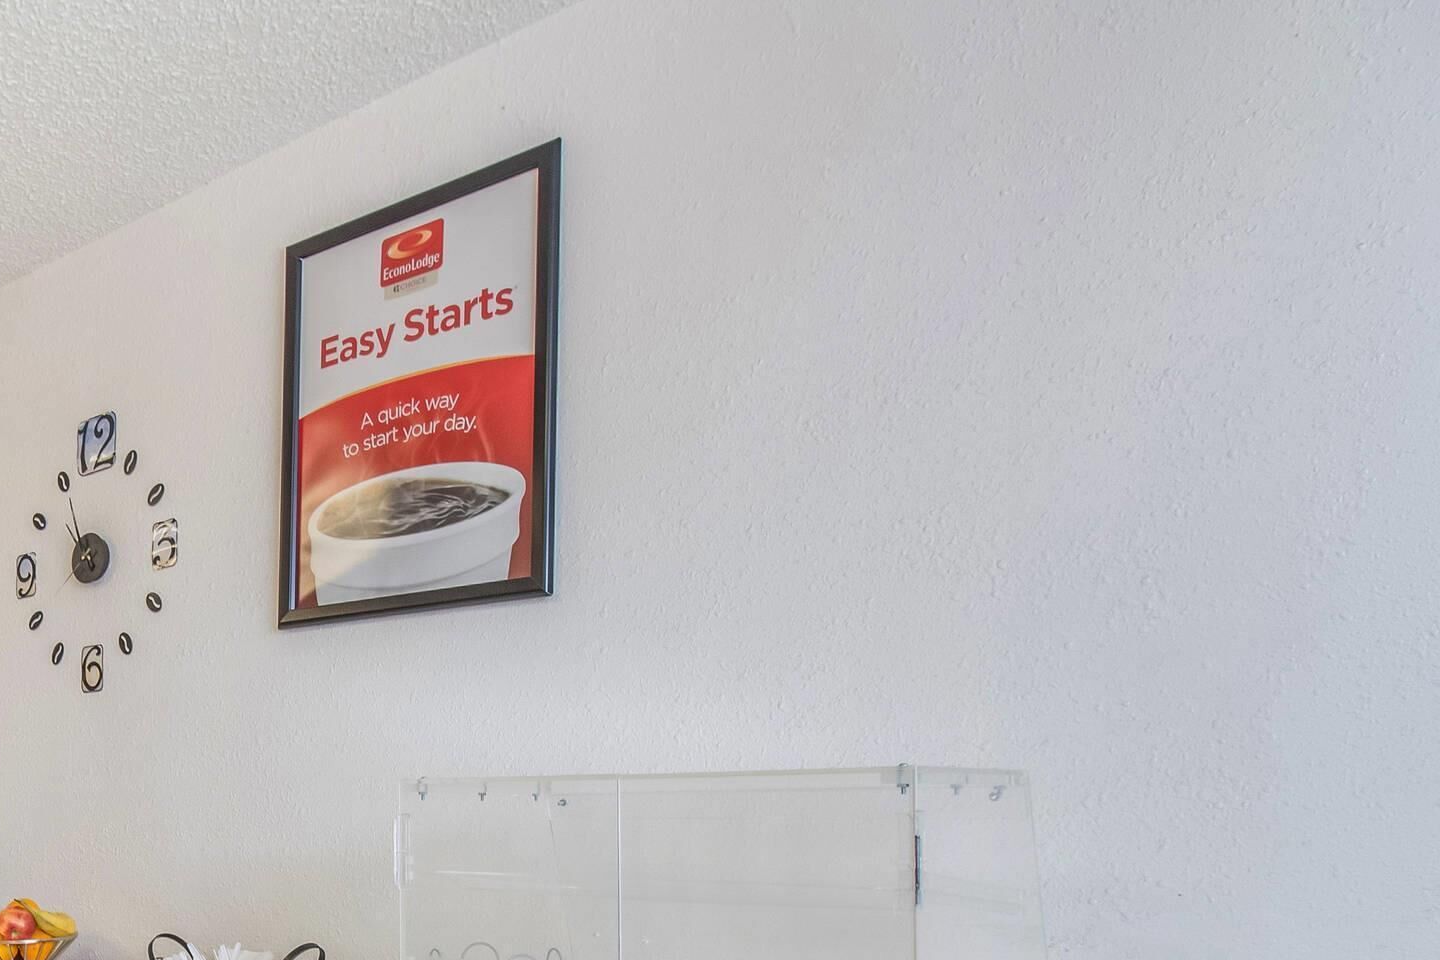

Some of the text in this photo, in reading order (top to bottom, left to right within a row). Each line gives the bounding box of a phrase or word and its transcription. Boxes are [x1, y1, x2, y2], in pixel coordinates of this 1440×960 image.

[383, 253, 440, 281] EconoLodge
[320, 287, 514, 369] Easy Starts
[361, 393, 460, 430] A quick way
[77, 413, 116, 474] 12
[342, 414, 478, 459] to start your day.
[16, 553, 36, 599] 9
[81, 644, 103, 692] 6
